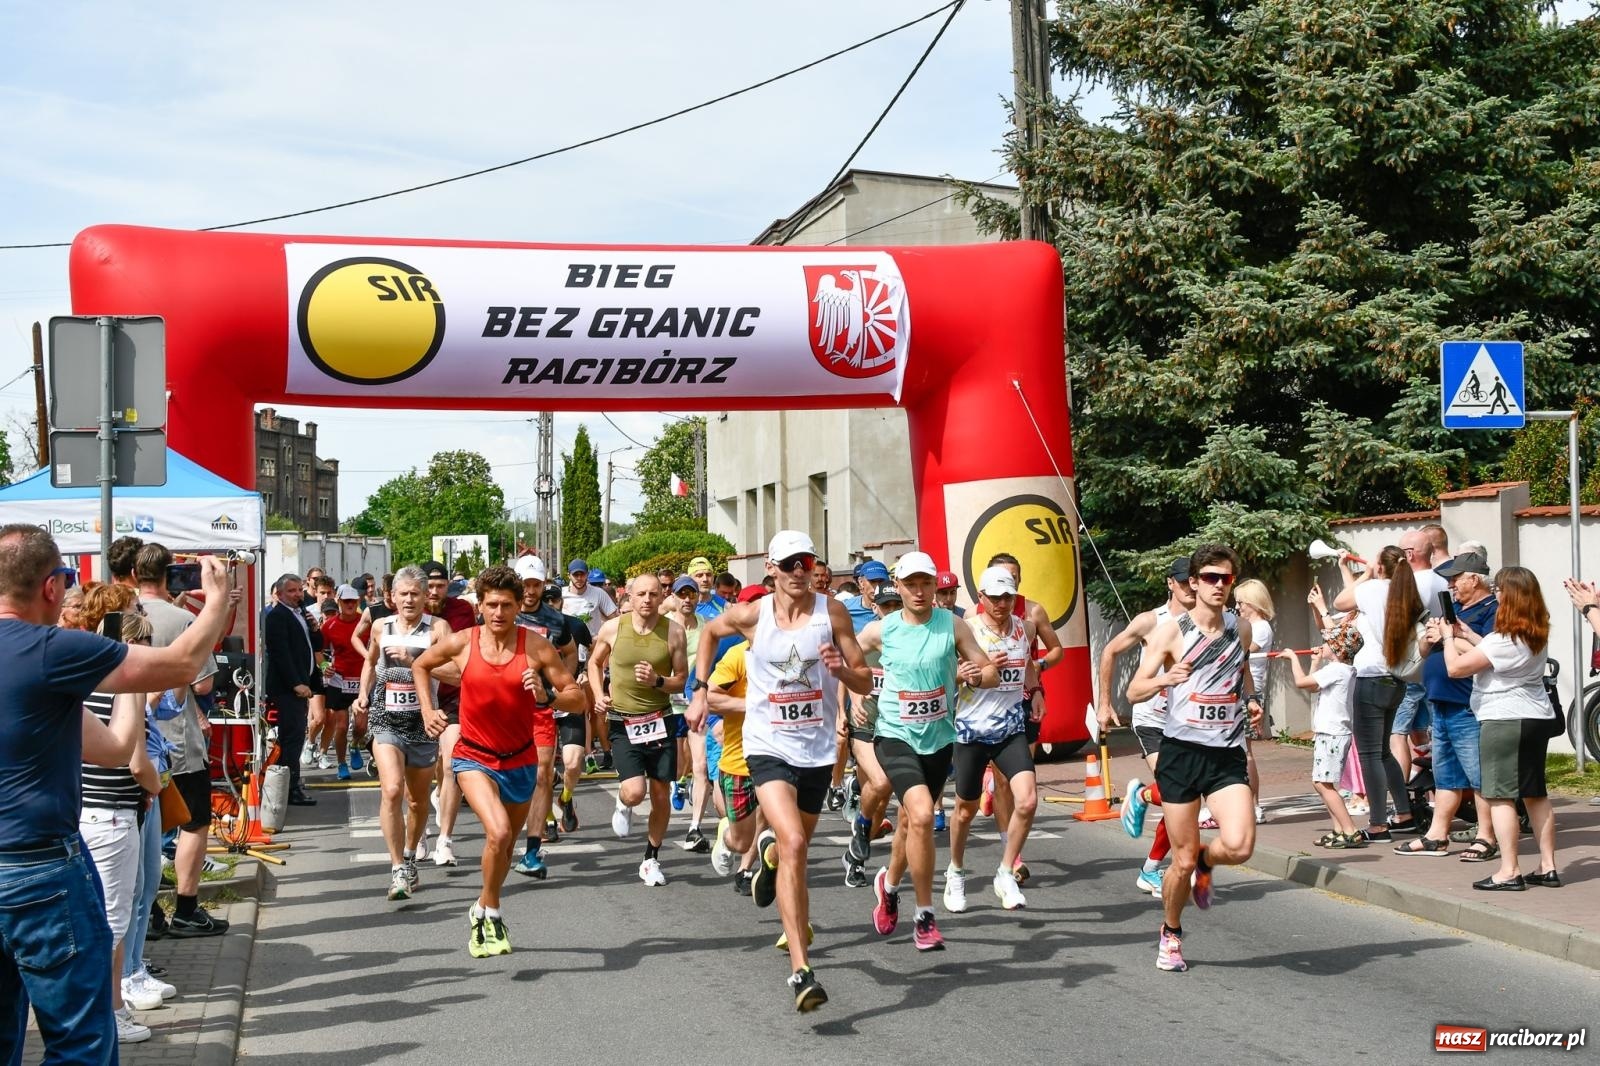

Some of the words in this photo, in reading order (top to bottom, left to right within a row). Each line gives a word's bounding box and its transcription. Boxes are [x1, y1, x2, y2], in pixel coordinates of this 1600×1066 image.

[564, 264, 676, 288] BIEG
[367, 275, 441, 302] SIR
[481, 306, 581, 338] BEZ
[587, 306, 761, 338] GRANIC
[501, 349, 738, 385] RACIBÓRZ
[211, 522, 238, 531] MITKO
[1025, 517, 1075, 545] SIR
[393, 692, 417, 704] 135
[907, 699, 940, 715] 238
[779, 703, 813, 721] 184
[1199, 705, 1227, 720] 136
[633, 721, 657, 736] 237
